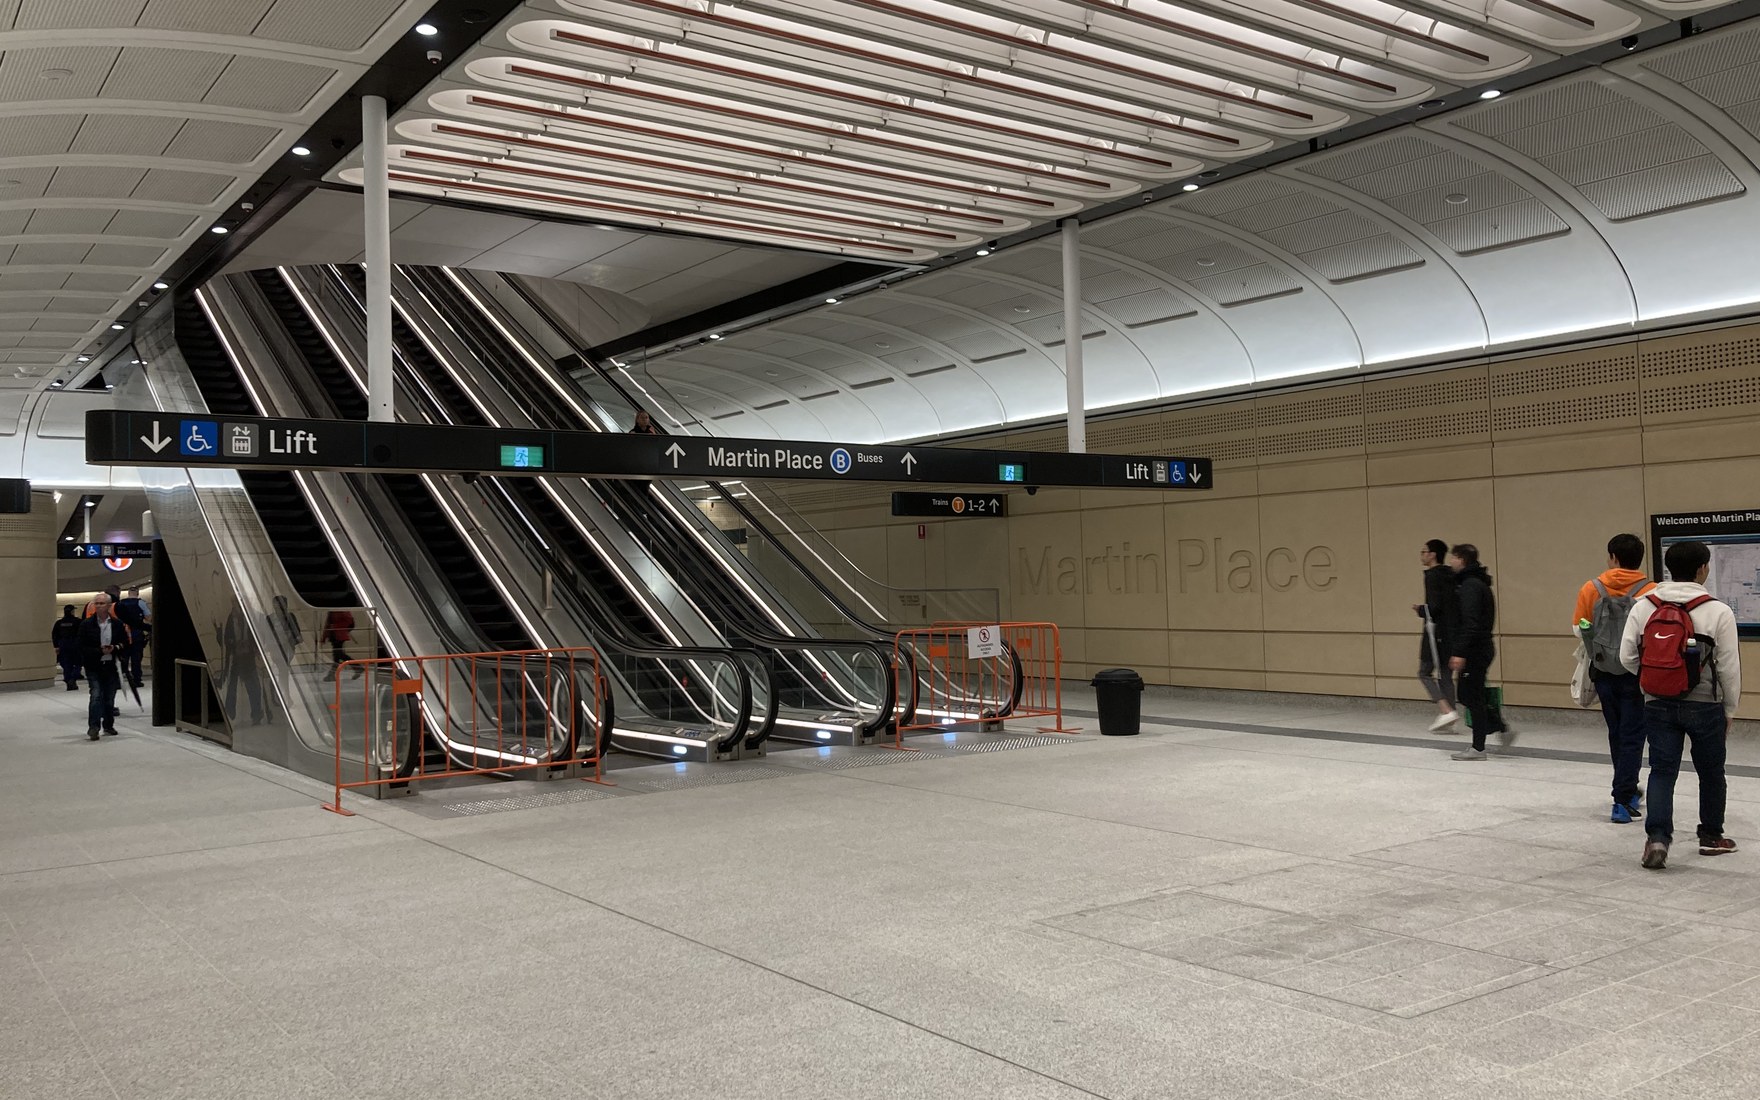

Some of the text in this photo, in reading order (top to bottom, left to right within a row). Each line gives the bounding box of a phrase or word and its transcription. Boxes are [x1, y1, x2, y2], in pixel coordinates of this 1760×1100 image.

[269, 429, 318, 454] Lift
[707, 447, 770, 468] Martin
[775, 449, 823, 470] Place
[857, 452, 884, 464] Buses
[1126, 463, 1150, 480] Lift
[932, 498, 949, 506] Trains
[968, 499, 986, 512] 1-2
[1656, 516, 1699, 526] Welcome
[1700, 515, 1711, 524] to
[1712, 513, 1744, 523] Martin
[1018, 537, 1338, 596] Martin Place
